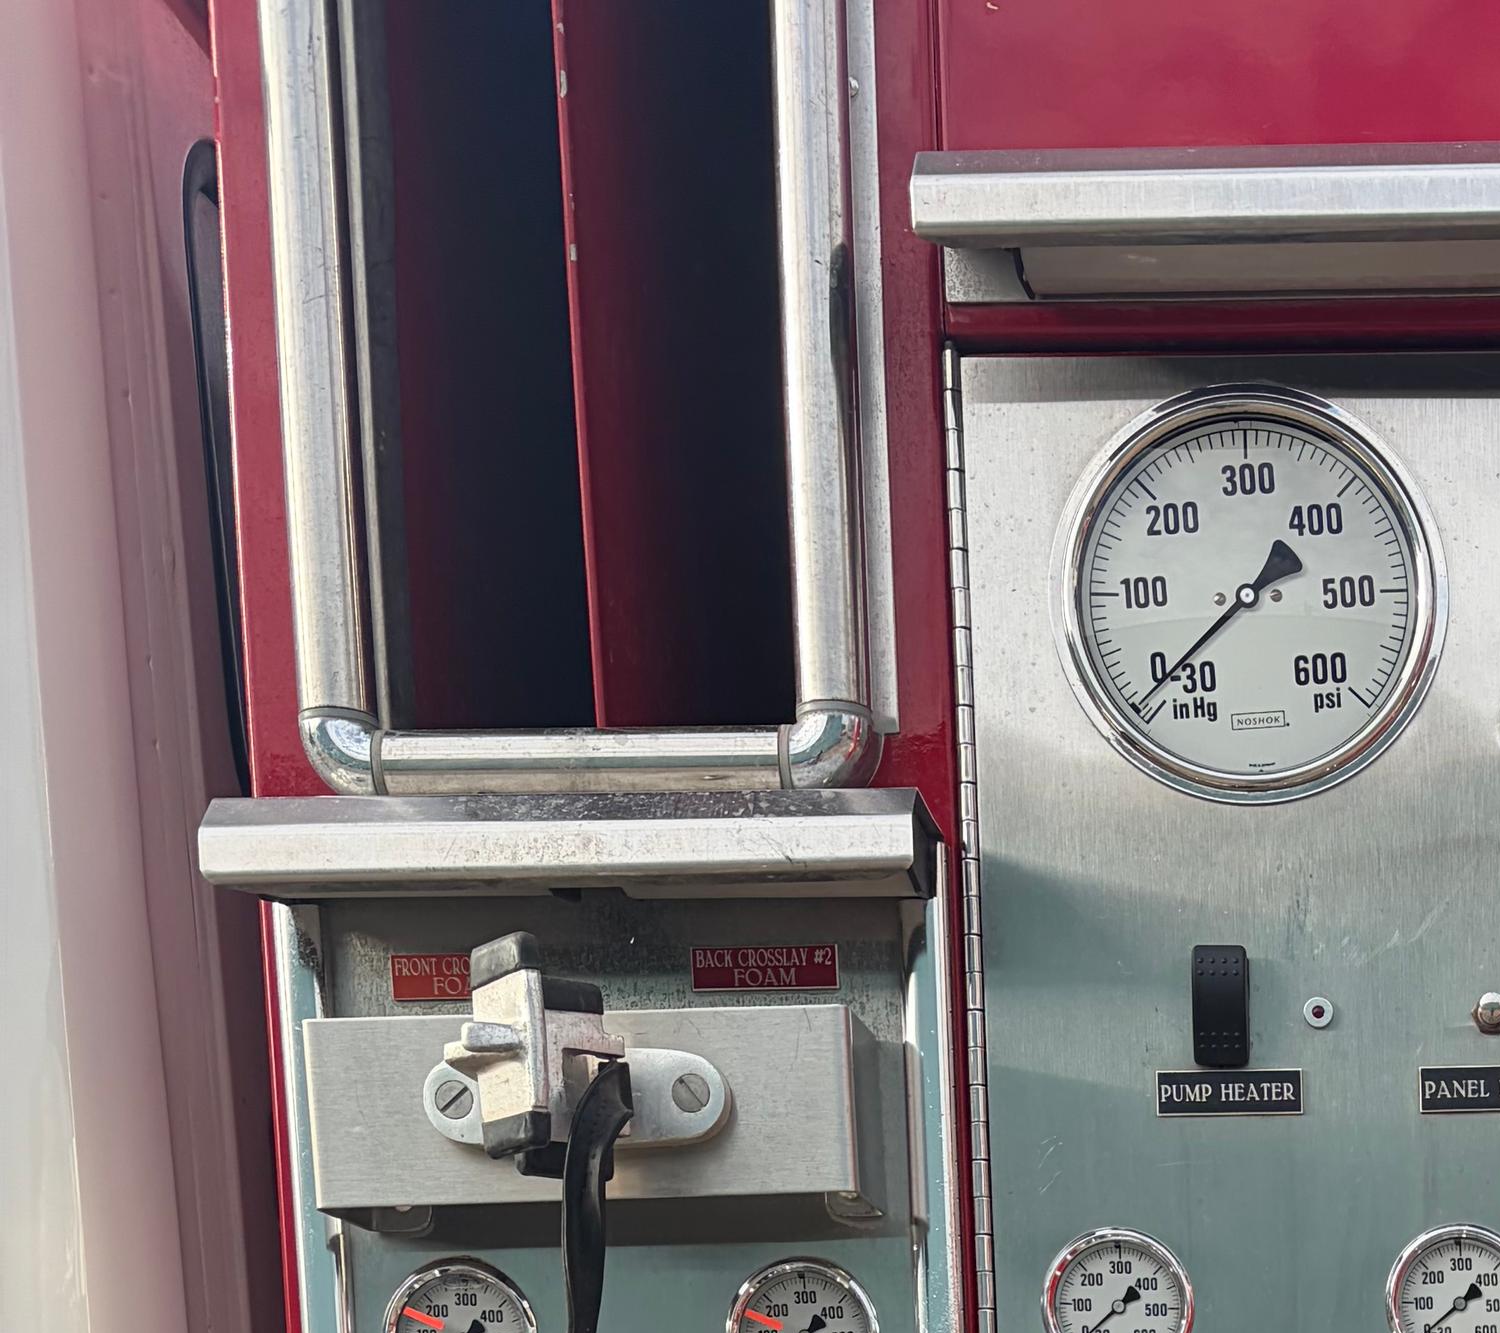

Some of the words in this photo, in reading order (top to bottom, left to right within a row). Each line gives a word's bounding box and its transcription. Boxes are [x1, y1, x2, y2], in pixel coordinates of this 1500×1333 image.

[1221, 461, 1276, 496] 300
[1146, 501, 1200, 536] 200
[1289, 502, 1343, 536] 400
[1120, 575, 1168, 608] 100
[1321, 574, 1375, 609] 500
[1294, 652, 1347, 686] 600
[1313, 688, 1342, 712] psi
[1236, 715, 1281, 728] NOSHOK
[696, 949, 732, 968] BACK
[737, 948, 809, 966] CROSSLAY
[813, 947, 833, 965] #2
[734, 968, 797, 986] FOAM
[1160, 1085, 1212, 1103] PUMP
[1220, 1082, 1296, 1102] HEATER
[1424, 1080, 1490, 1099] PANEL
[1108, 1260, 1132, 1275] 300
[1145, 1303, 1168, 1317] 500
